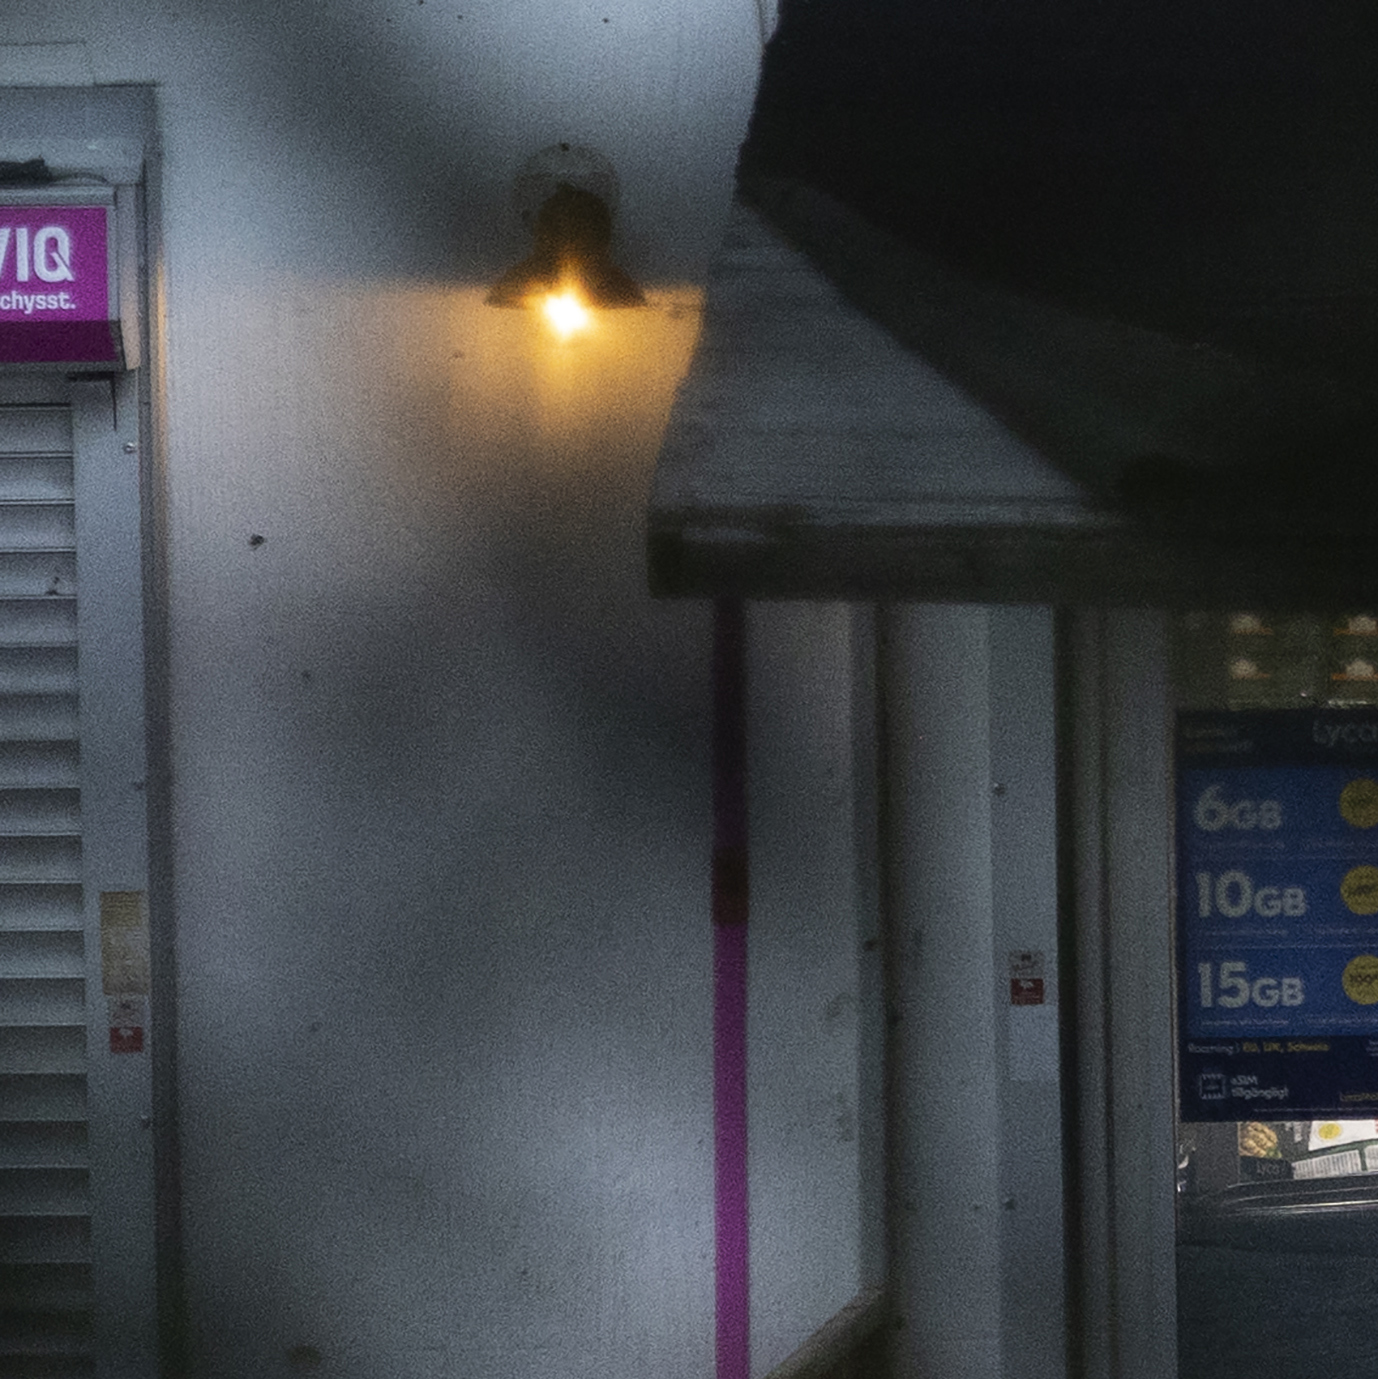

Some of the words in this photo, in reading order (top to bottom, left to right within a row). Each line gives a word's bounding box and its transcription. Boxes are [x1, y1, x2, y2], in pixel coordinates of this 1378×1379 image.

[1195, 783, 1283, 831] 6GB
[1195, 870, 1308, 918] 10GB
[1198, 961, 1306, 1009] 15GB
